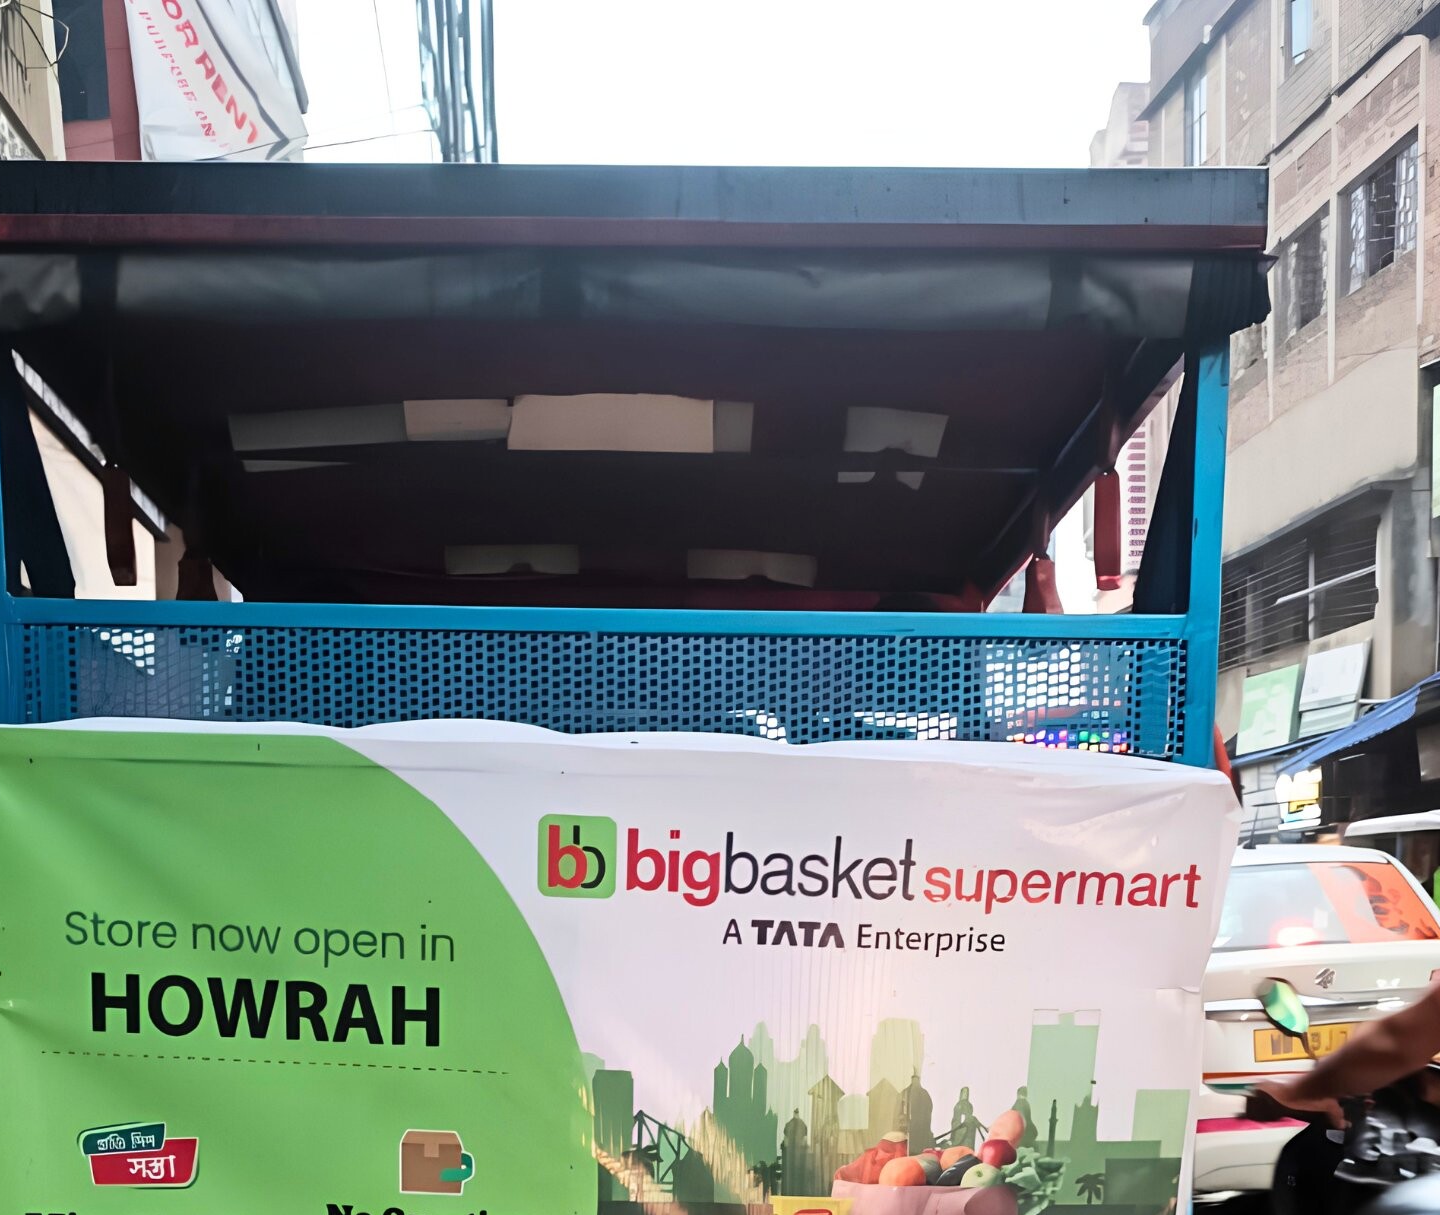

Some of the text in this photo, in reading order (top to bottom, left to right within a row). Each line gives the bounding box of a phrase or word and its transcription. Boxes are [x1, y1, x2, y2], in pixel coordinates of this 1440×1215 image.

[626, 828, 916, 907] bigbasket
[924, 864, 1201, 914] supermart
[66, 912, 454, 968] Store now open in
[723, 919, 1005, 957] A TATA Enterprise
[91, 972, 439, 1047] HOWRAH
